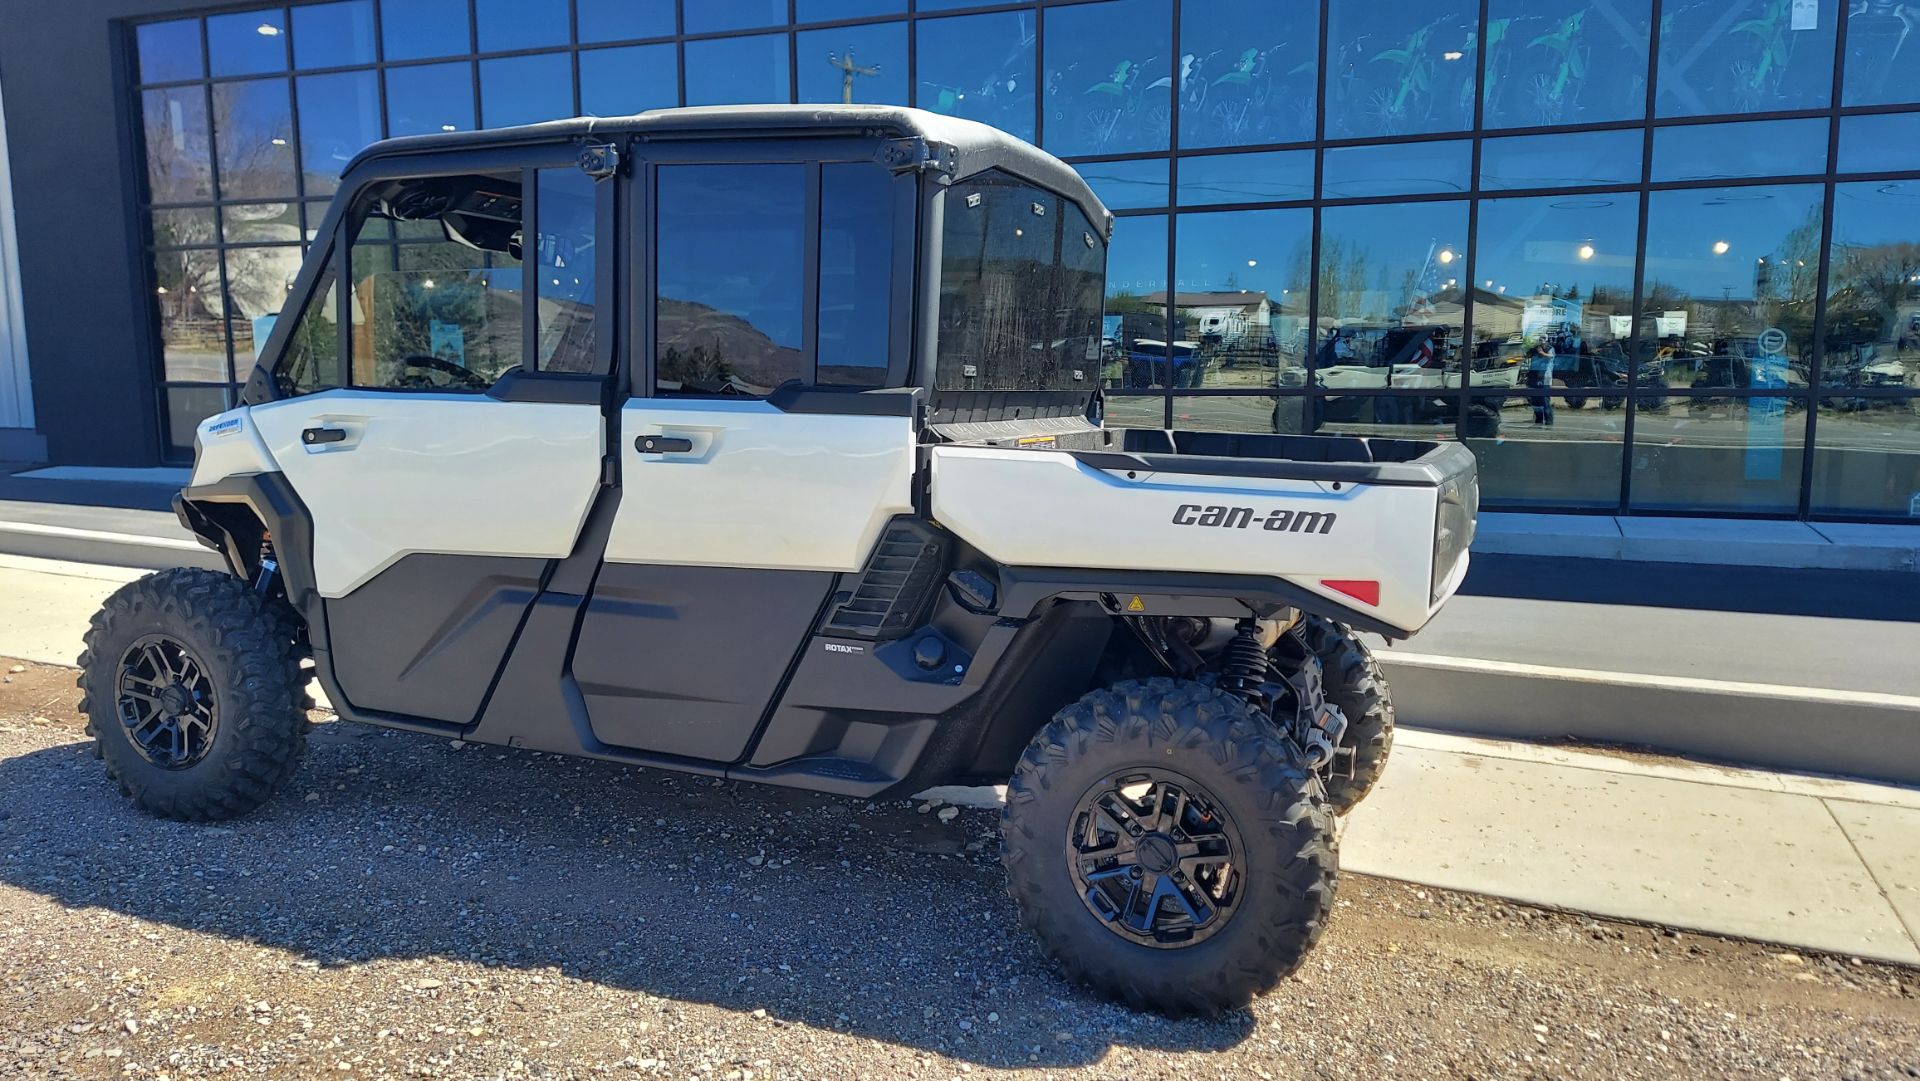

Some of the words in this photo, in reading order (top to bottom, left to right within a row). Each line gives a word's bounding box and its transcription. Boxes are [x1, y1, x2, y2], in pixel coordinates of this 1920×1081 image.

[1108, 279, 1211, 289] NDERALL
[1172, 504, 1337, 534] can-am
[825, 643, 853, 654] ROTAX
